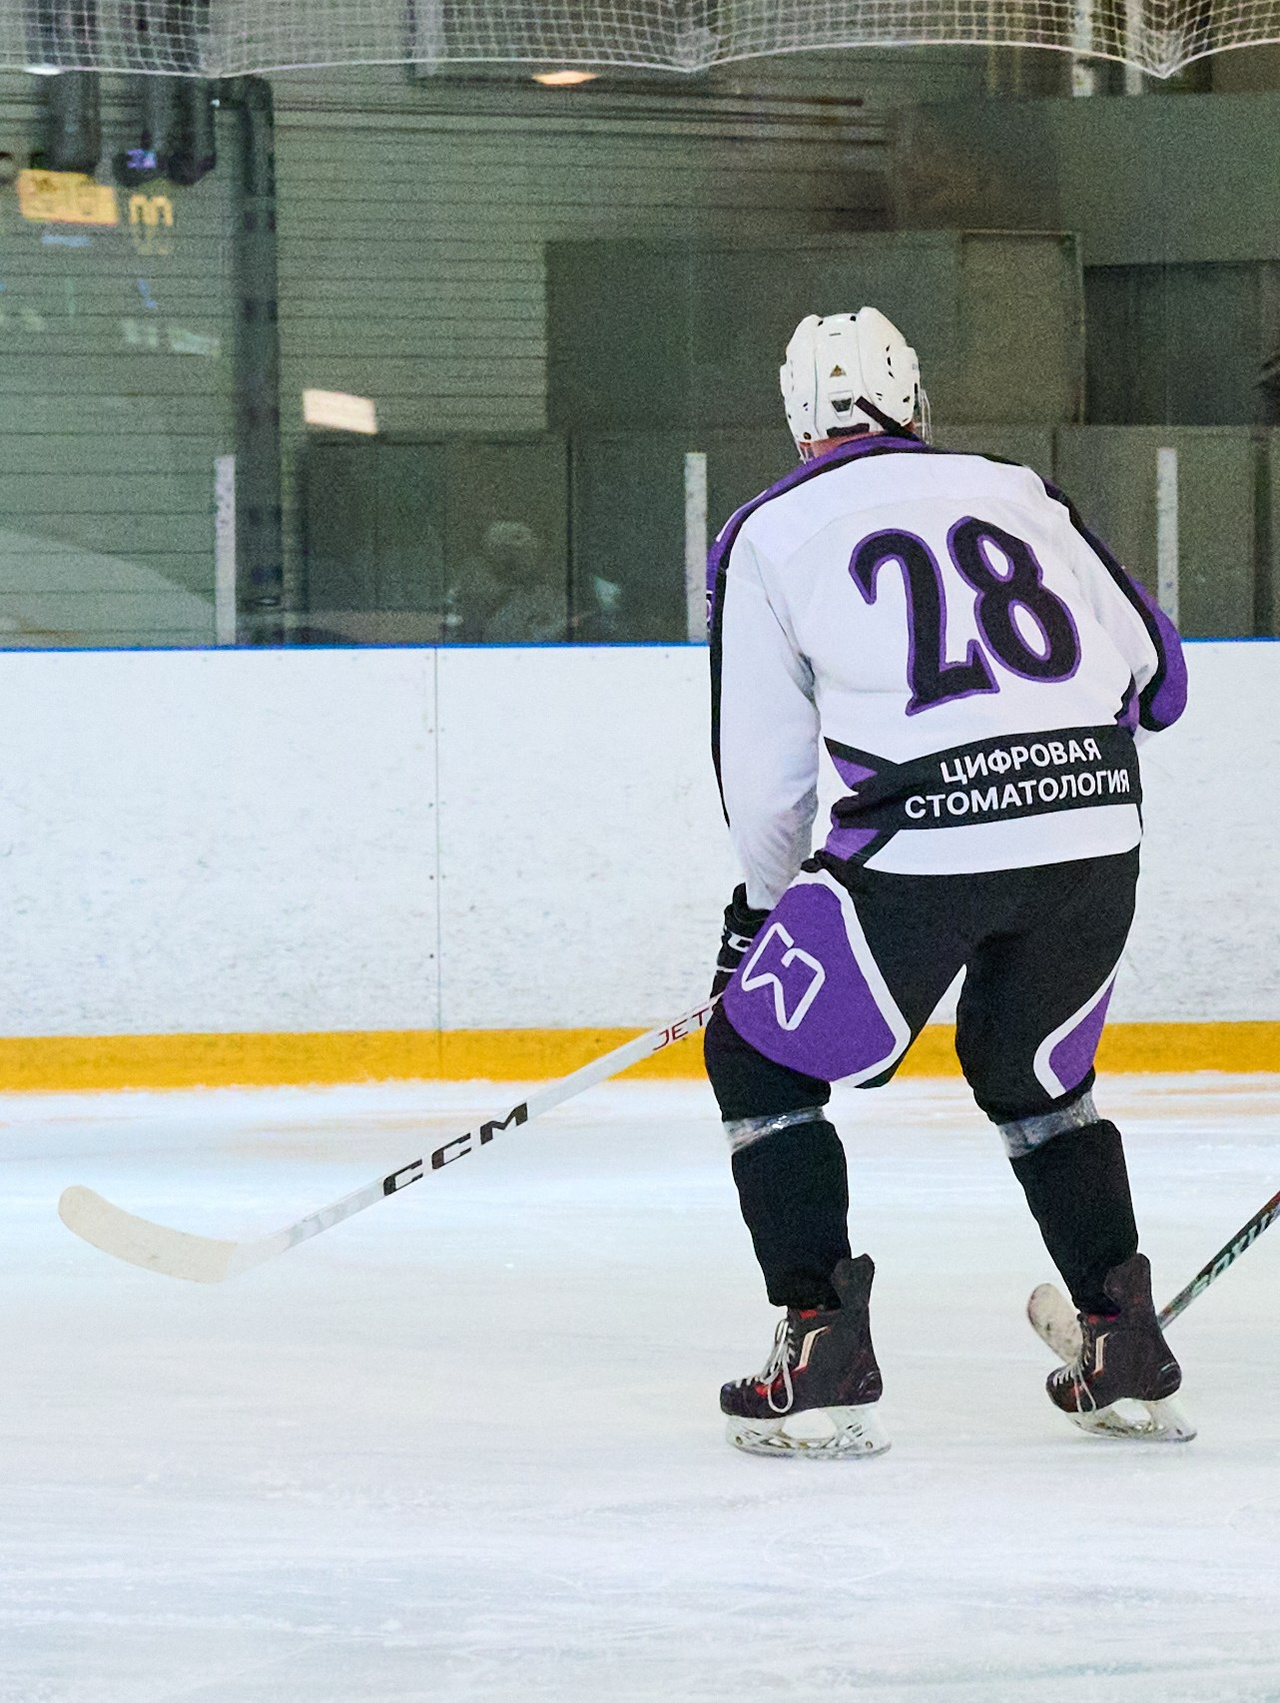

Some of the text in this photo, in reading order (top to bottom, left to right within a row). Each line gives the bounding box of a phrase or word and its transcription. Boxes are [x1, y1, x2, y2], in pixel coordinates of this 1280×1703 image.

[848, 516, 1082, 717] 28
[939, 737, 1102, 785] ЦИФРОВАЯ
[904, 768, 1131, 820] СТОМАТОЛОГИЯ
[652, 1003, 716, 1051] JET
[383, 1101, 528, 1196] CCM
